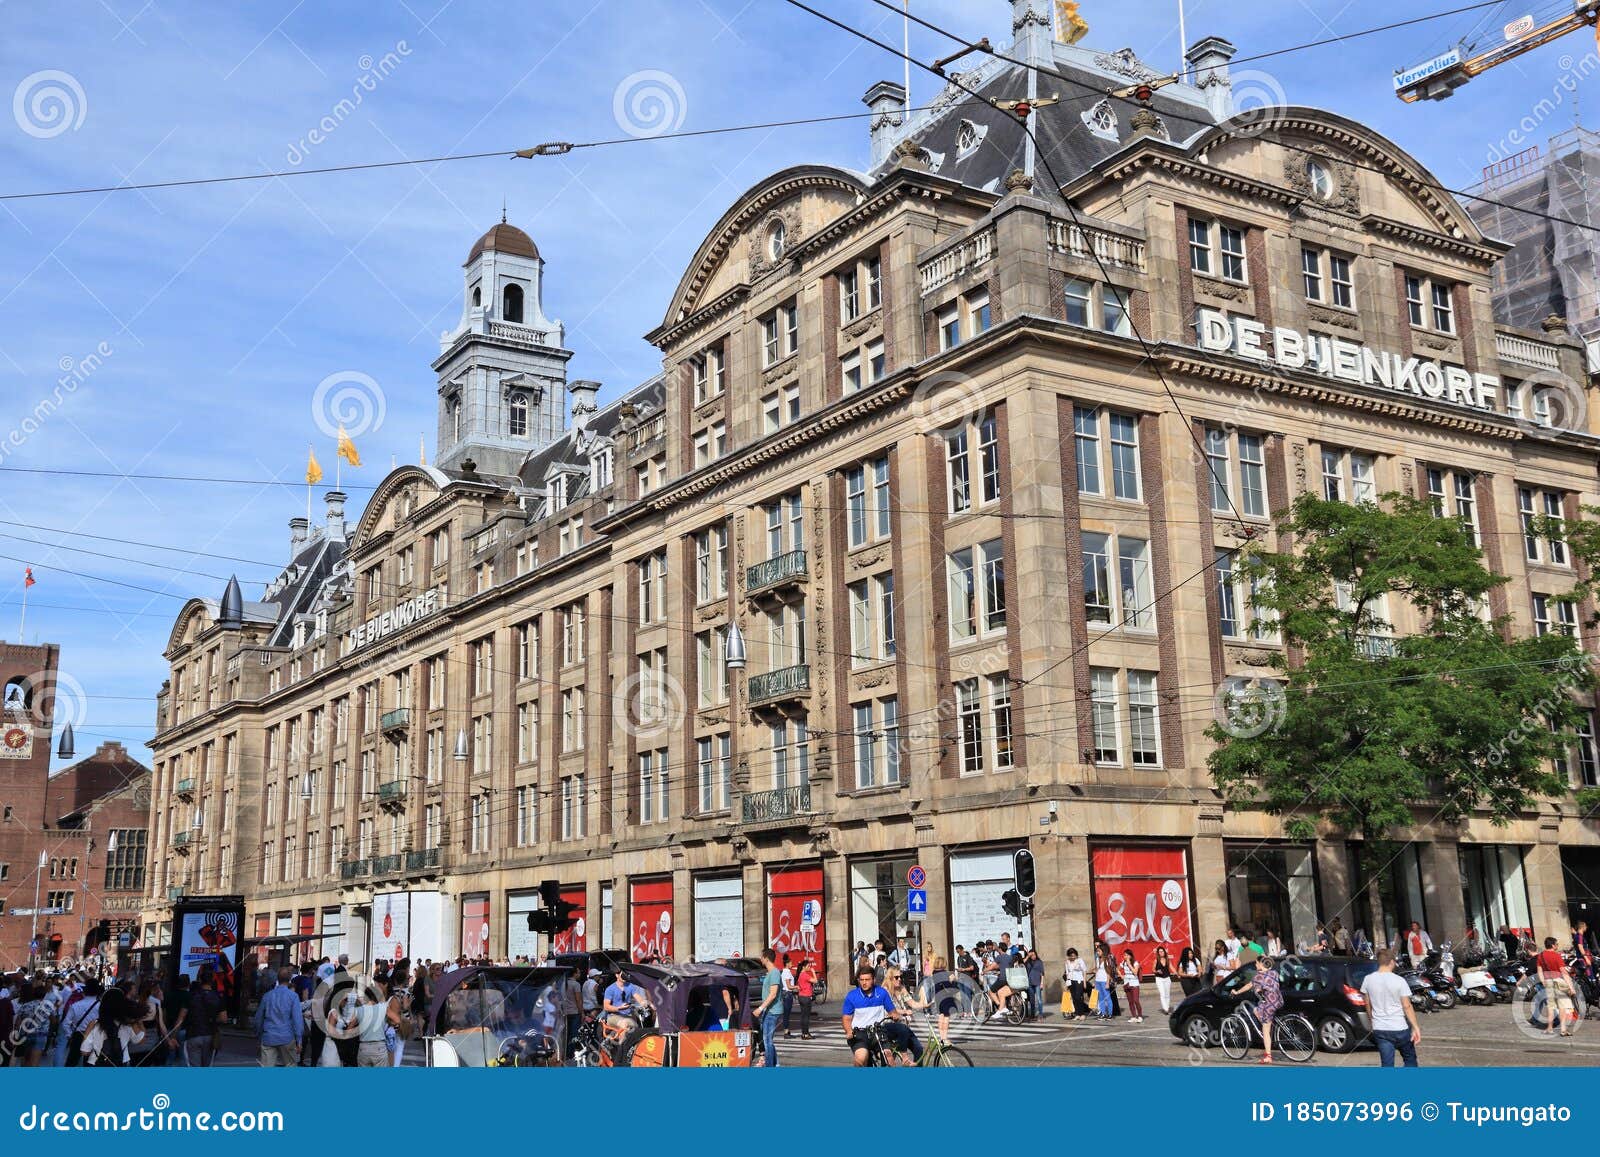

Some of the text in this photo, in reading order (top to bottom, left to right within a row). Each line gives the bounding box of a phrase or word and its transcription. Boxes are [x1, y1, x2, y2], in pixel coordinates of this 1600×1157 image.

[1396, 55, 1457, 86] Verwelius
[1196, 309, 1500, 409] DE BIJENKORF
[348, 625, 366, 651] DE
[1163, 891, 1182, 902] 70%
[1097, 892, 1185, 945] Sale
